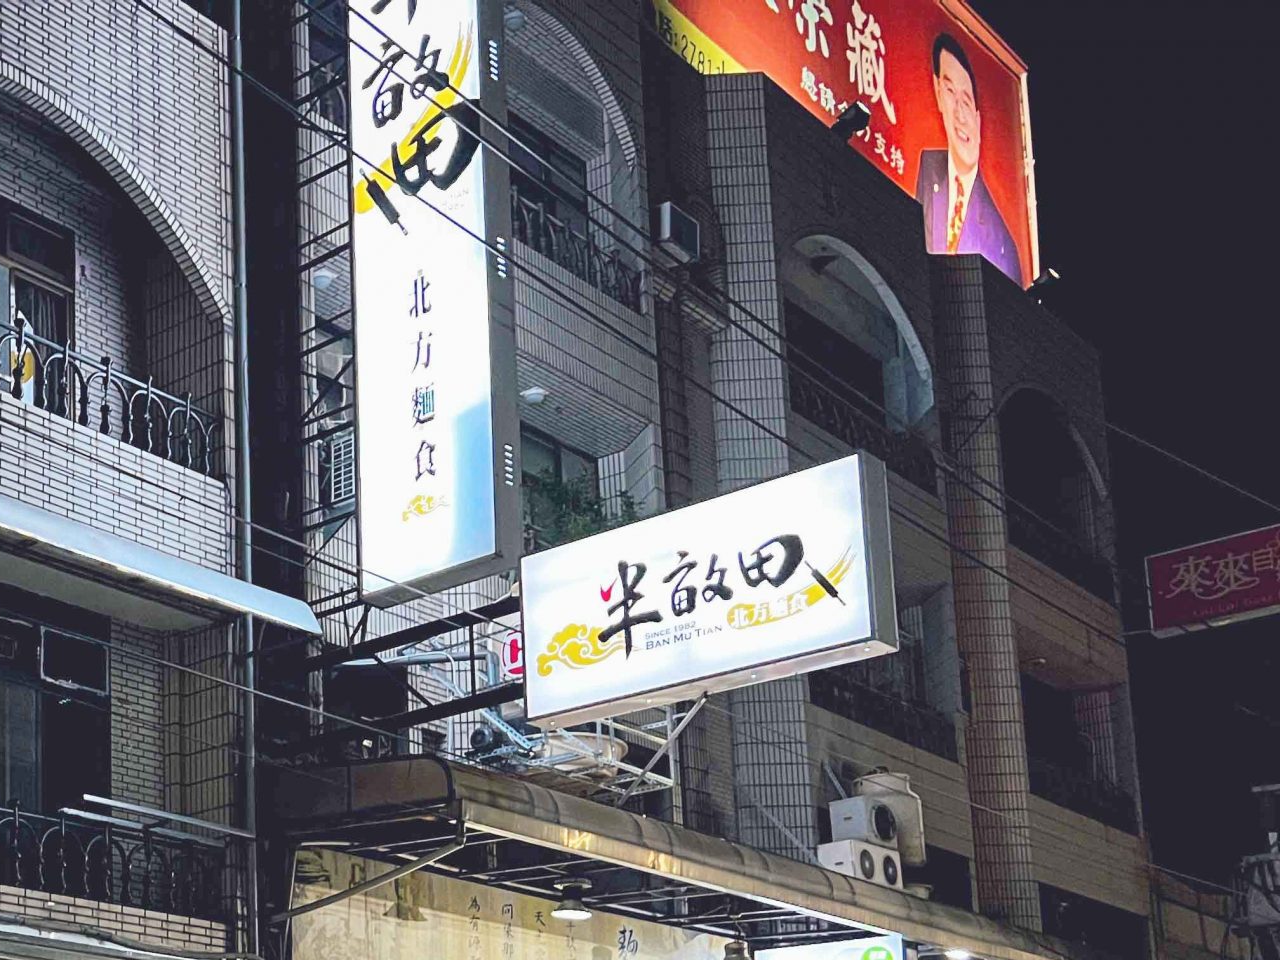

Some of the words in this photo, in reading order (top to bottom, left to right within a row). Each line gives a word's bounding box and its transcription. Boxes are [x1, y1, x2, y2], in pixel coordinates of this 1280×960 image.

[800, 65, 905, 176] 懇請支持
[409, 274, 437, 482] 北方麵食
[644, 628, 671, 640] SINCE
[673, 620, 697, 633] 1982
